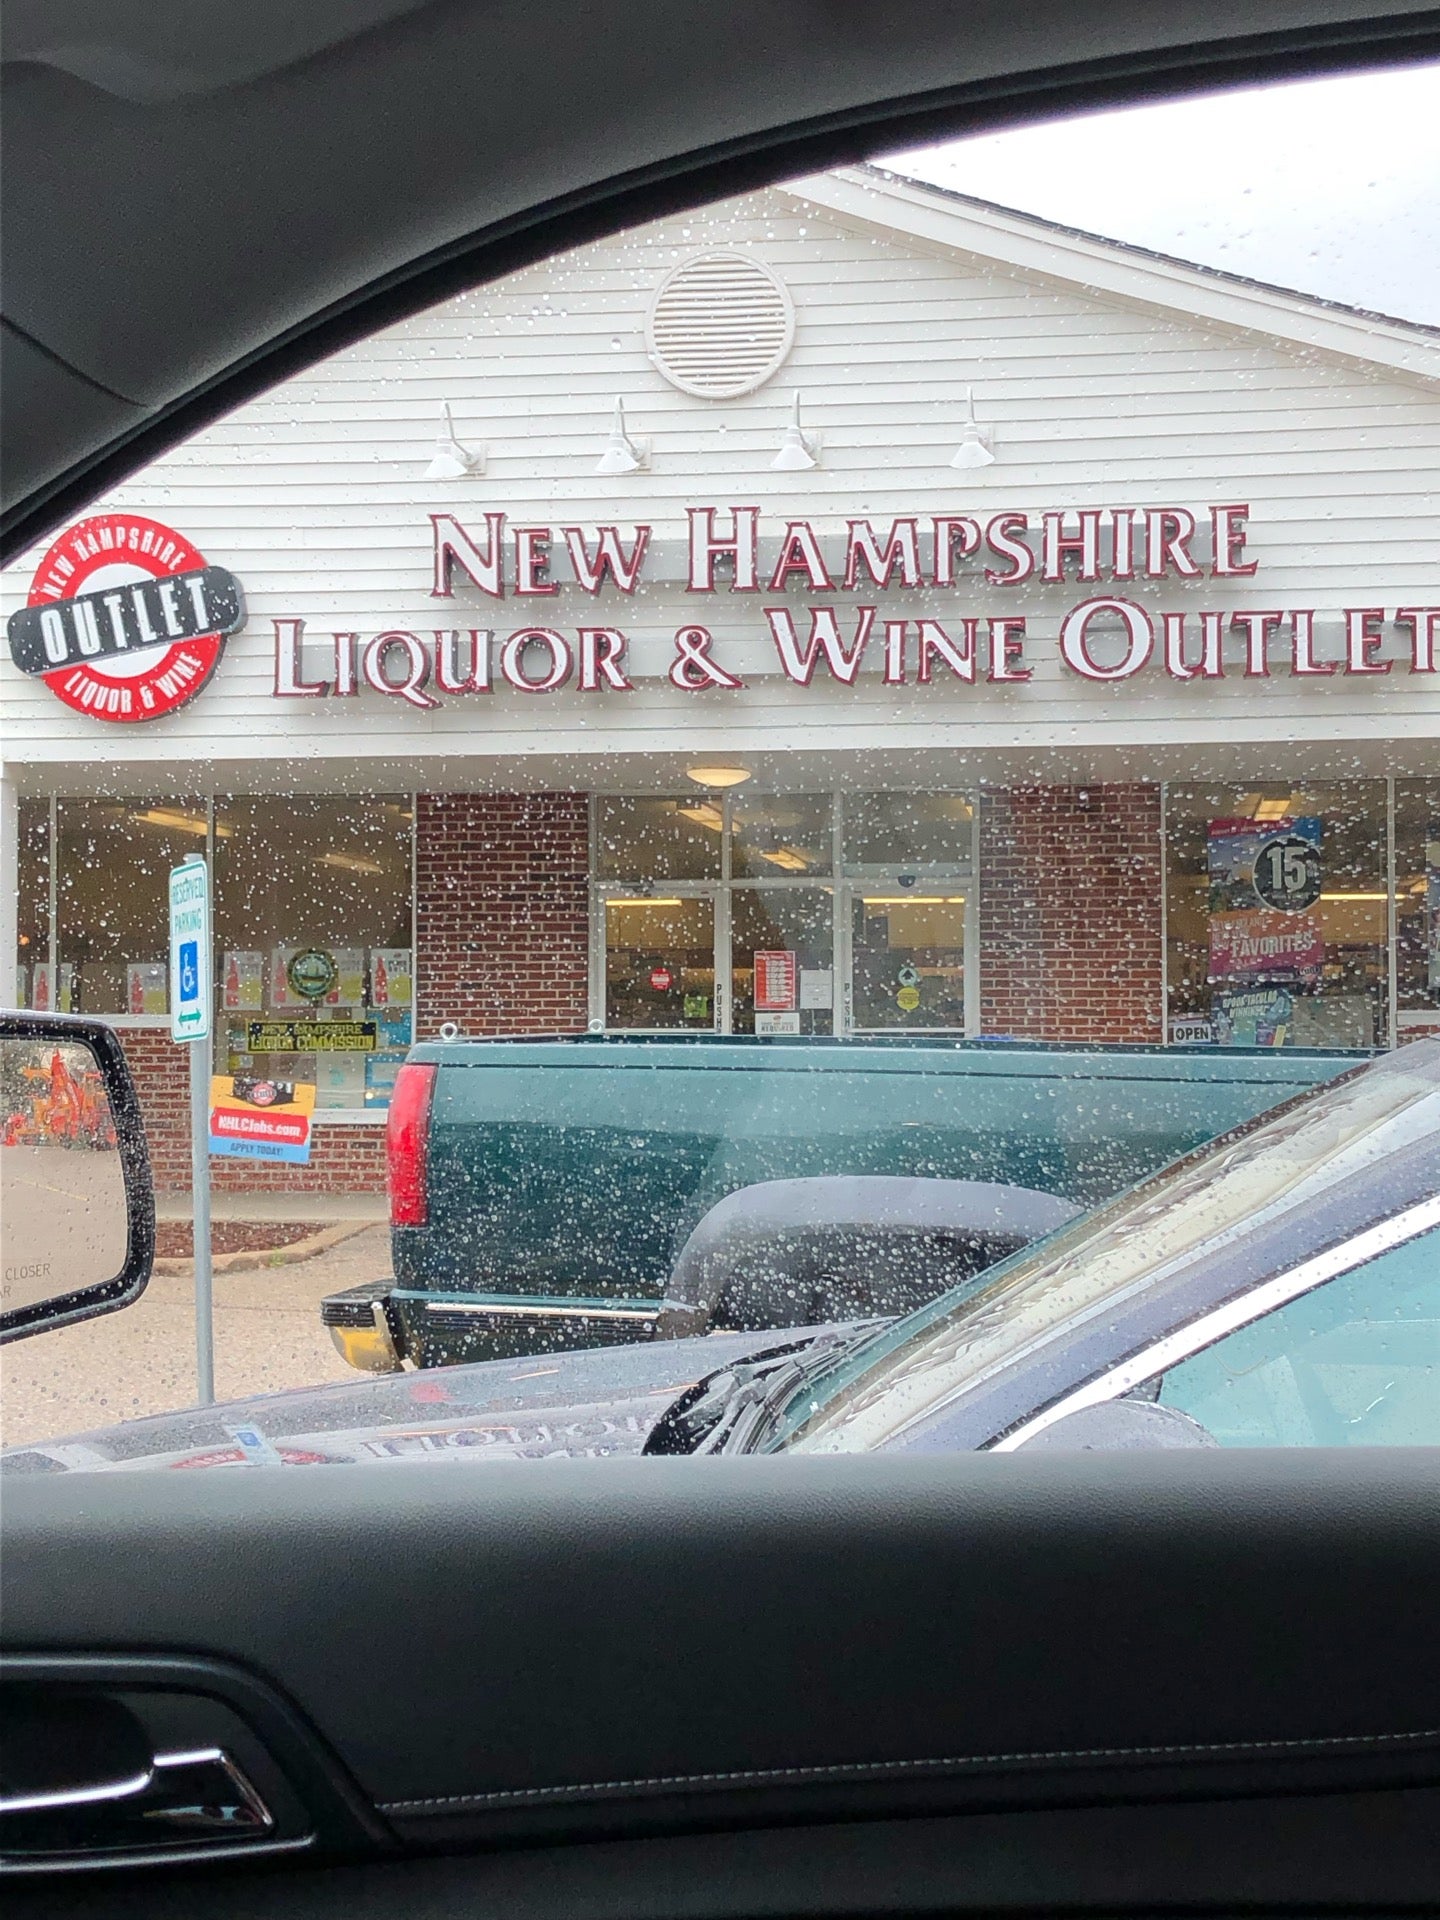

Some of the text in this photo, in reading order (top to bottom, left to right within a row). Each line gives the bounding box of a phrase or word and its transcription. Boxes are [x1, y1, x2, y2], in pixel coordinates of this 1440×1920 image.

[42, 526, 186, 598] NEW HAMPSHIRE
[40, 576, 210, 663] OUTLET
[669, 624, 749, 691] &
[64, 652, 202, 713] LIQUOR & WINE
[1266, 846, 1307, 893] 15
[172, 876, 205, 905] RESERVED
[174, 908, 202, 932] PARKING
[1230, 930, 1314, 958] FAVORITES
[250, 1035, 374, 1050] LIQUOR COMMISSION
[261, 1024, 362, 1035] NEW HAMPSHIRE
[1175, 1026, 1209, 1041] OPEN
[218, 1115, 301, 1137] NHLCJobs.com
[230, 1142, 284, 1156] APPLY TODAY!
[5, 1263, 50, 1281] CLOSER
